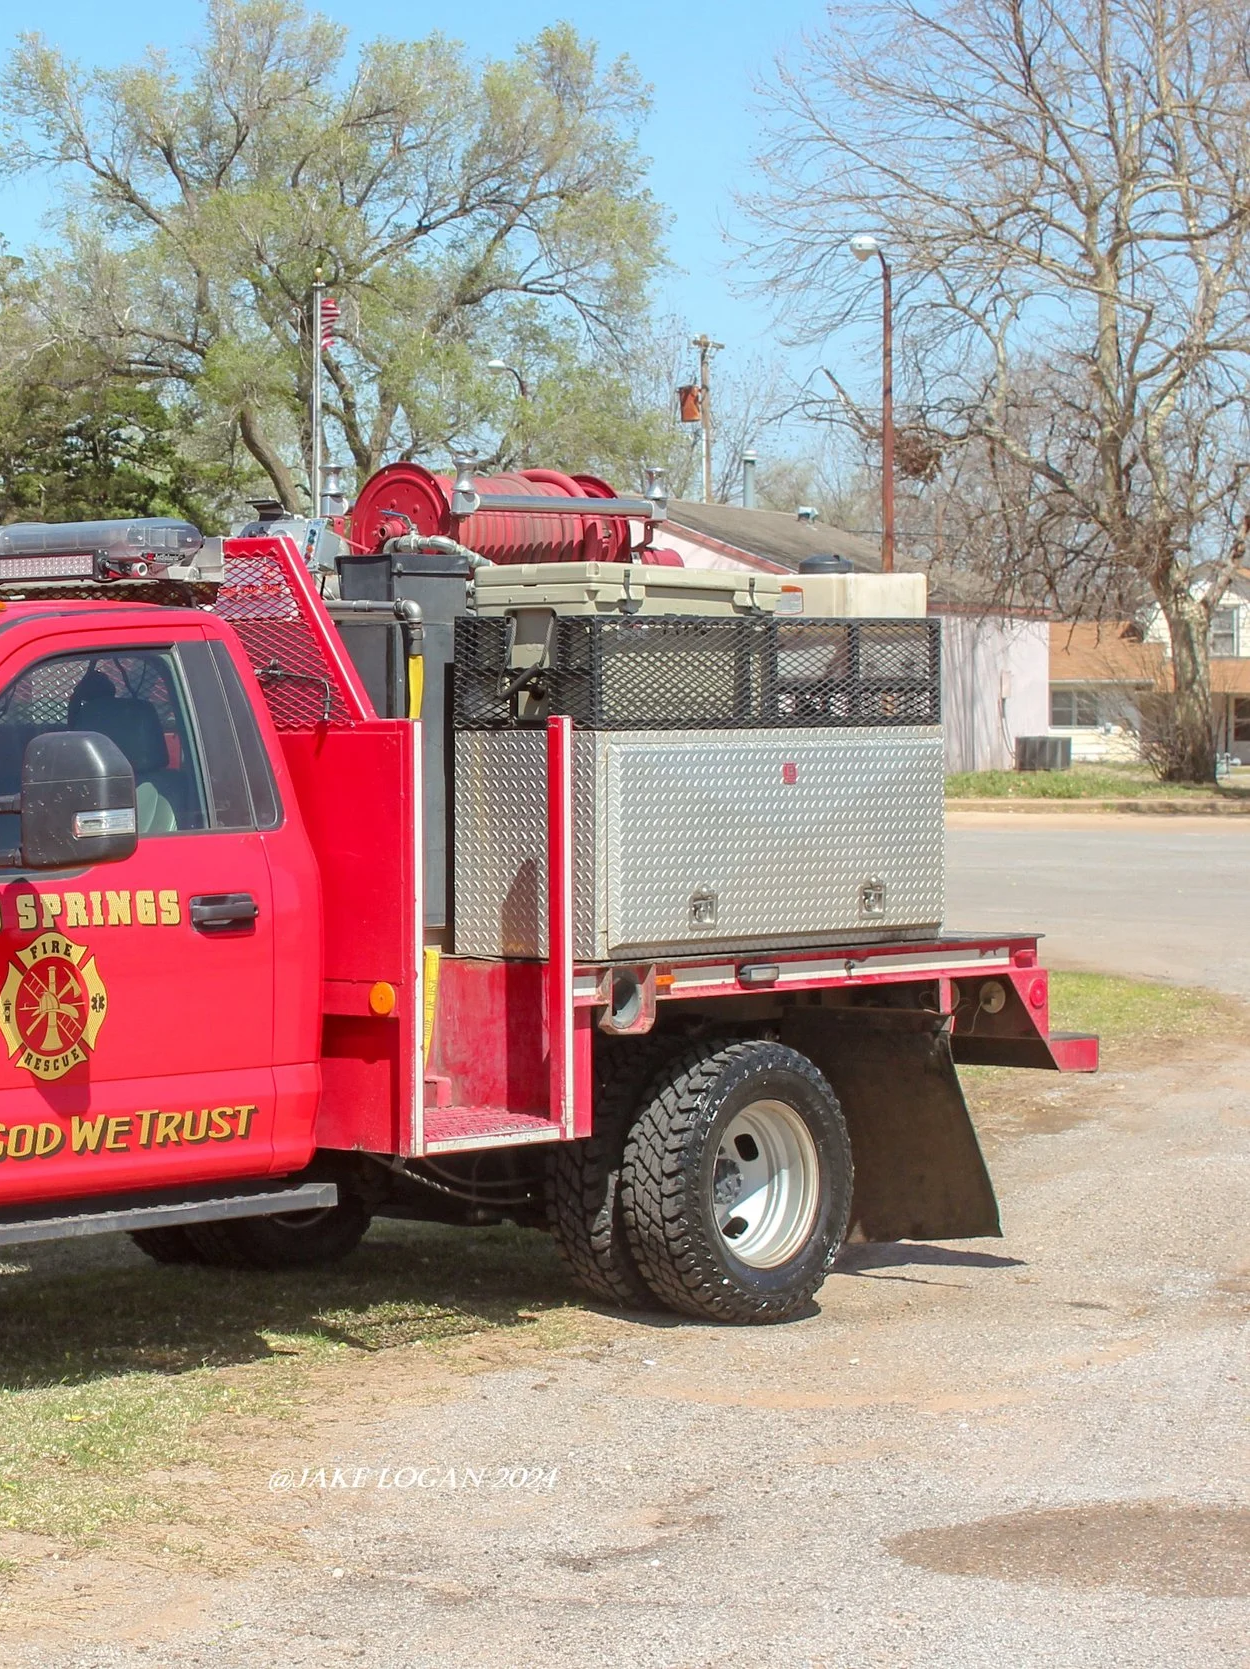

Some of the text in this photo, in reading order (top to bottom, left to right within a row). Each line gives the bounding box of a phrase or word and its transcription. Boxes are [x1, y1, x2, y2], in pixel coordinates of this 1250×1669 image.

[17, 889, 181, 930] SPRINGS
[29, 939, 75, 961] FIRE
[23, 1048, 81, 1073] RESCUE
